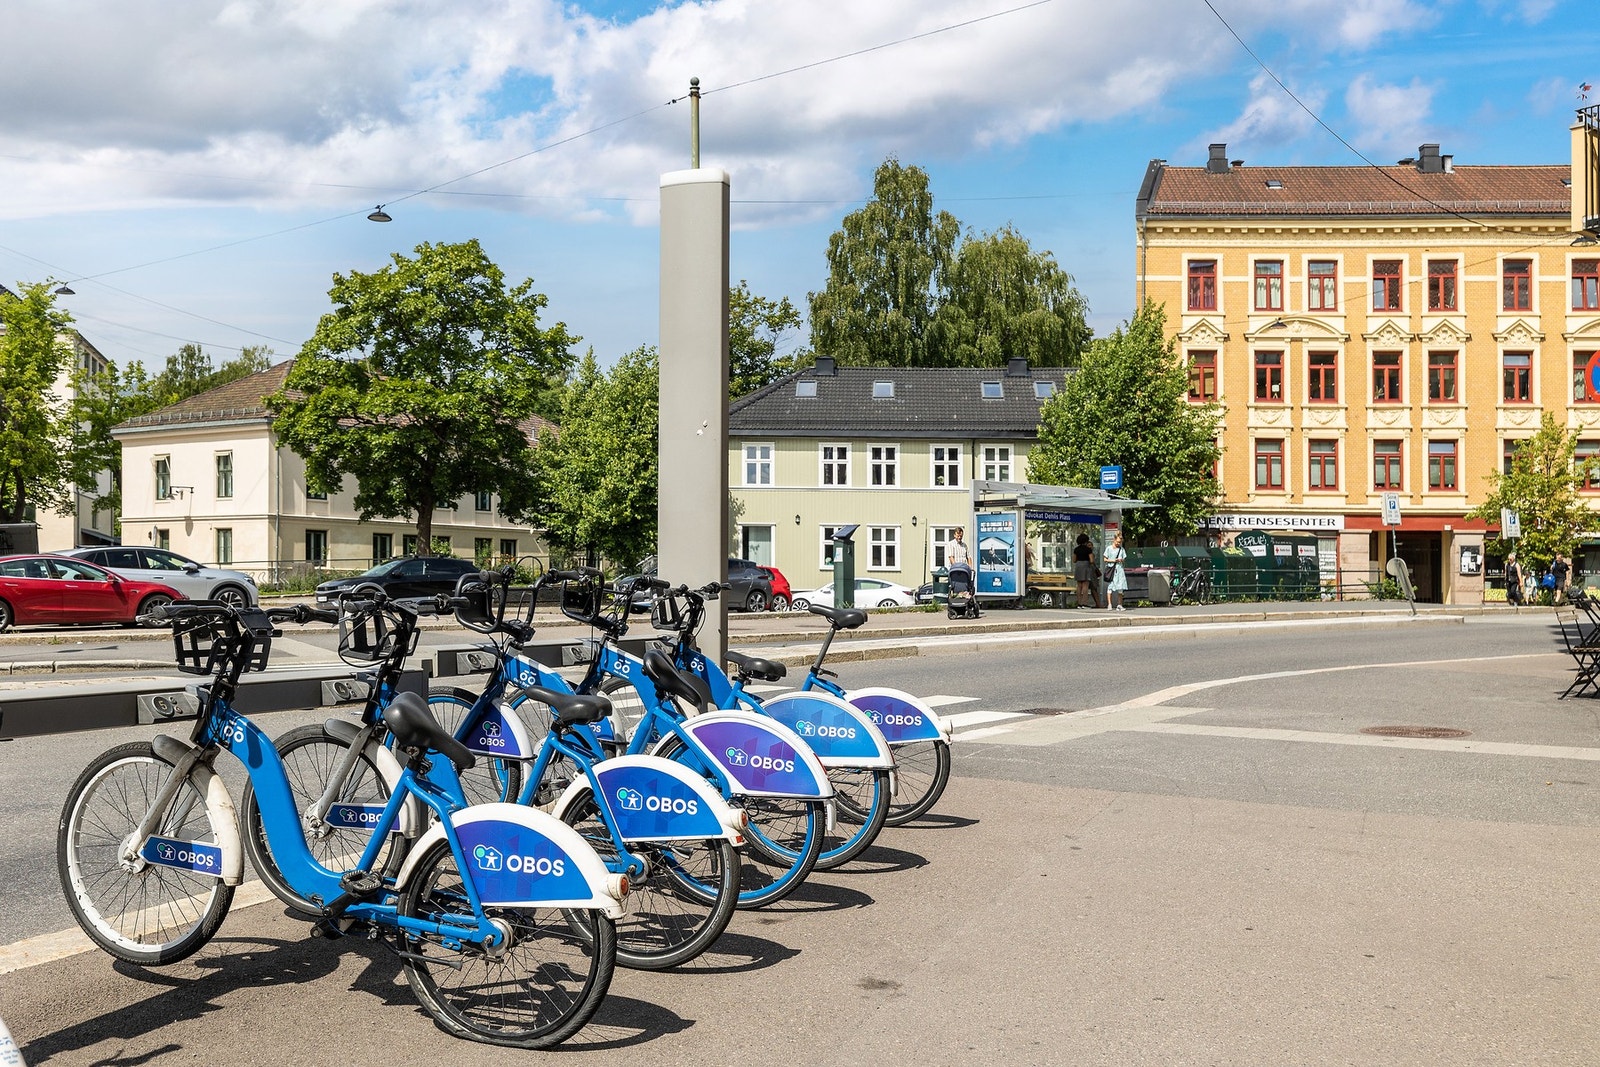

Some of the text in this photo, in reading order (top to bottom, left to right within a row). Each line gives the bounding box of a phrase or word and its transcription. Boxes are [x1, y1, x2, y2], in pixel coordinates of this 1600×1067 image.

[1197, 516, 1336, 526] GENE RENSESENTER
[158, 700, 168, 710] 5
[885, 714, 922, 726] OBOS
[817, 726, 856, 739] OBOS
[479, 737, 505, 747] OBOS
[750, 755, 795, 773] OBOS
[646, 796, 698, 815] OBOS
[359, 813, 383, 823] OBO
[178, 850, 214, 867] OBOS
[506, 854, 565, 877] OBOS
